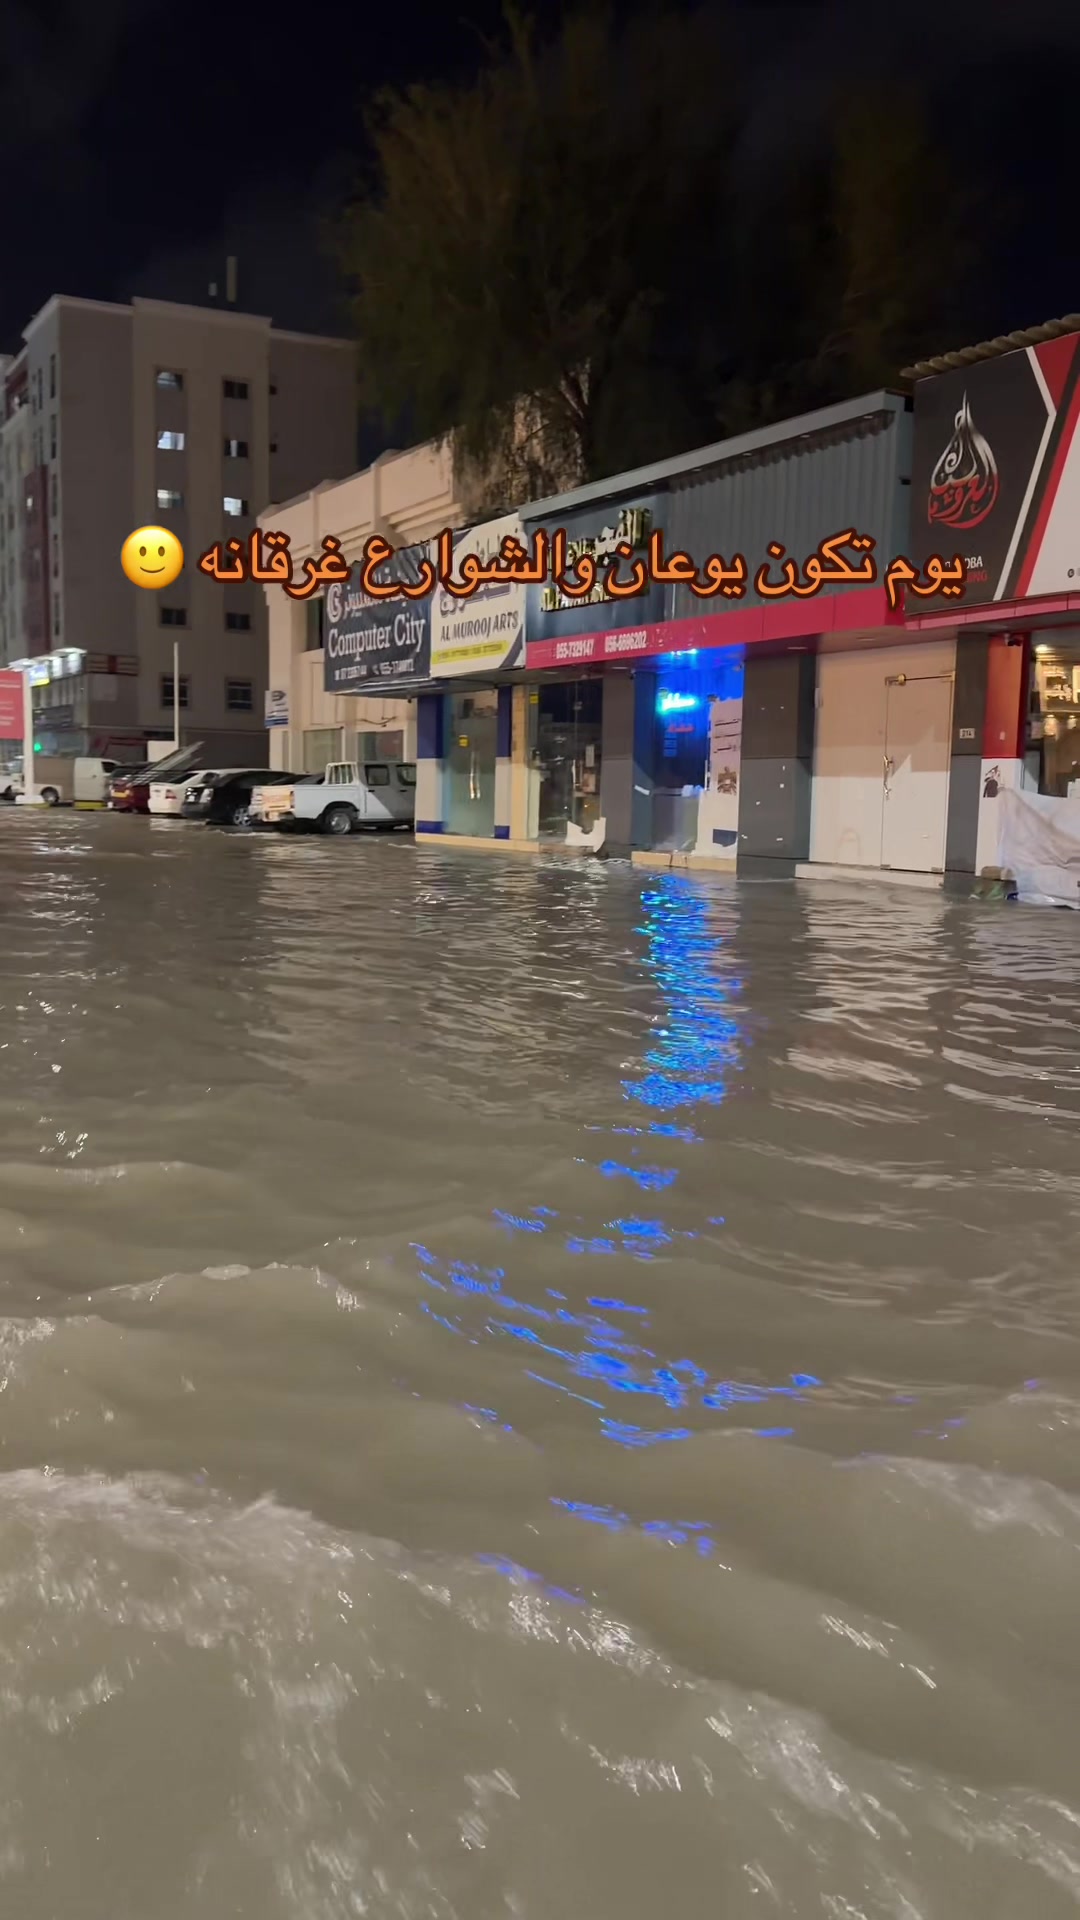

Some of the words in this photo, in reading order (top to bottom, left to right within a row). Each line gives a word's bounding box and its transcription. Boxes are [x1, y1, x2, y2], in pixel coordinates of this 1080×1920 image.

[328, 624, 392, 662] Computer
[393, 612, 426, 653] City
[441, 624, 451, 642] AL
[453, 616, 492, 640] MUROOJ
[492, 610, 519, 632] ARTS
